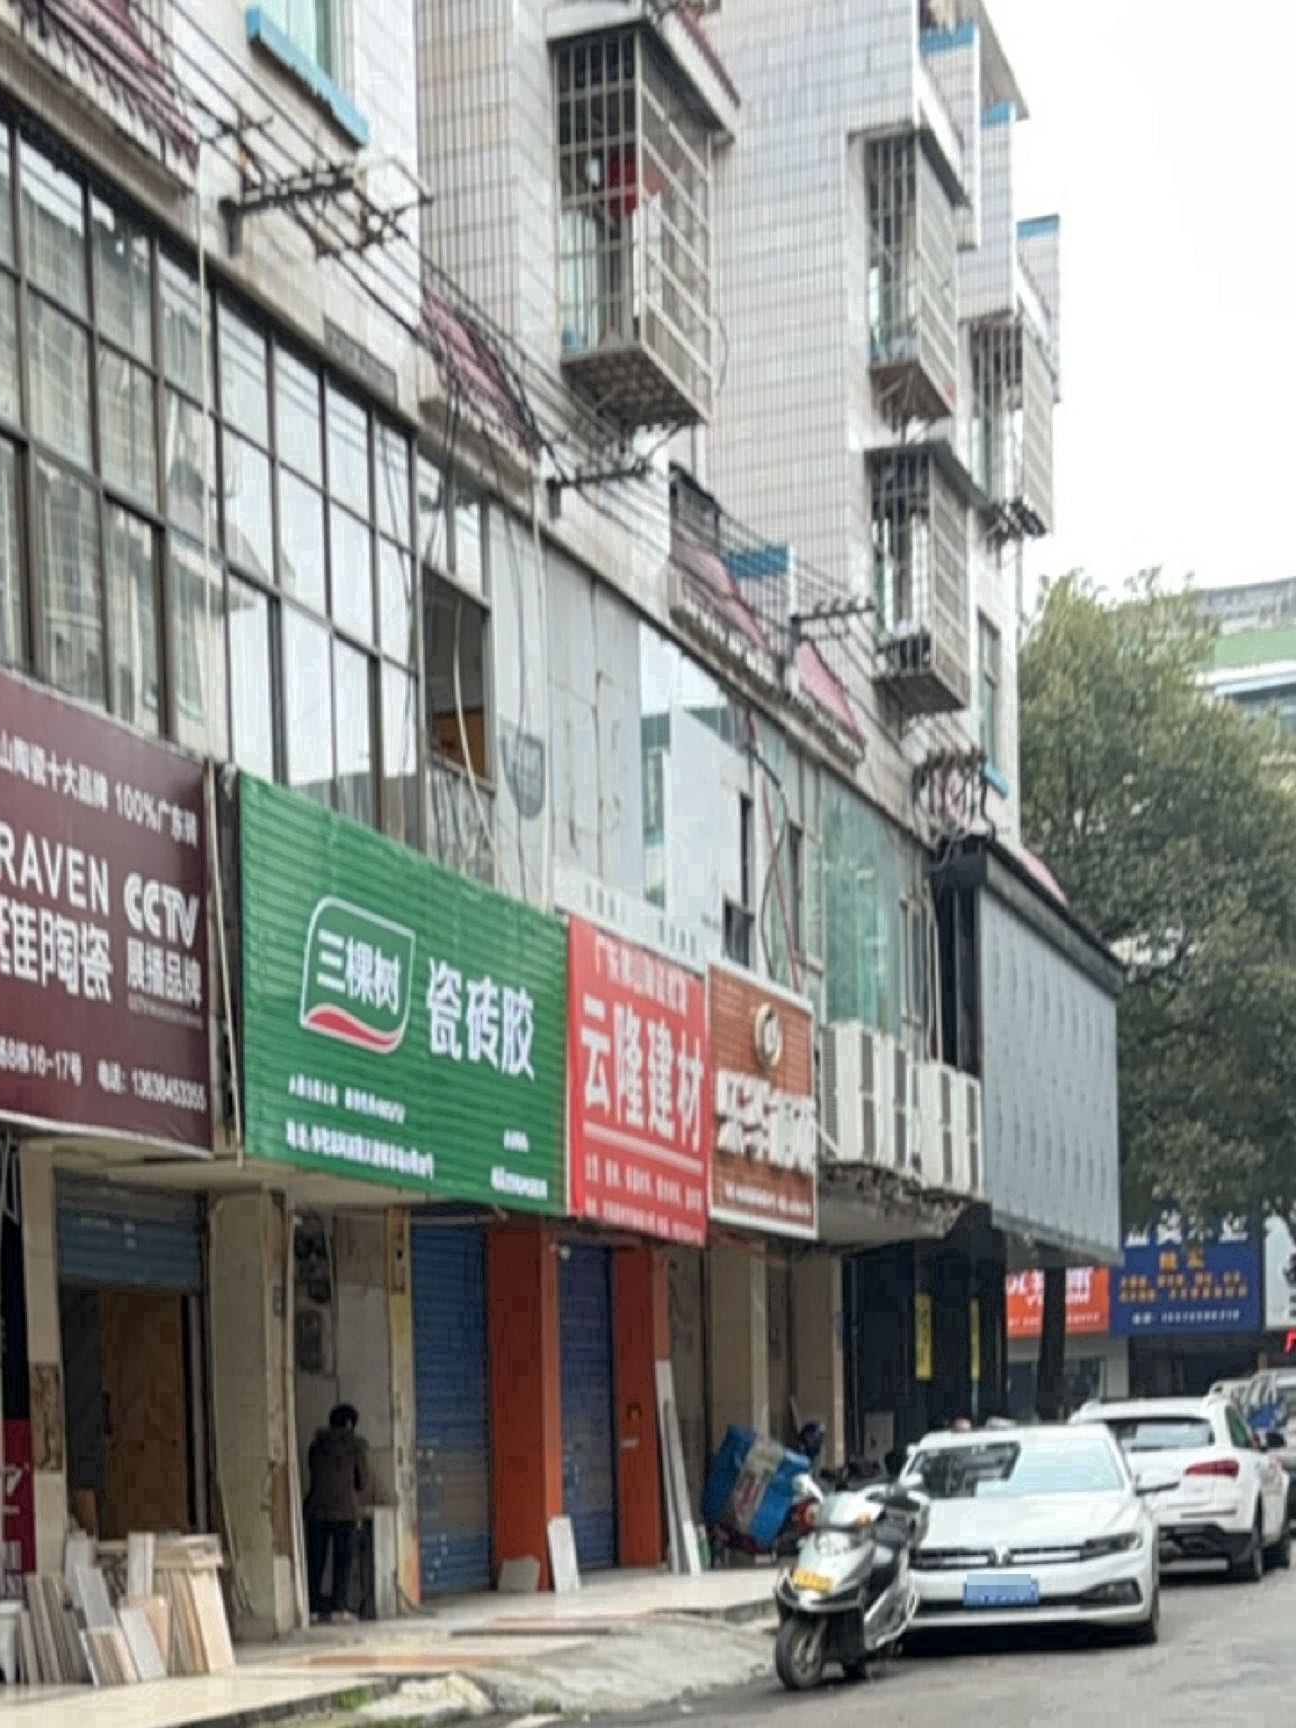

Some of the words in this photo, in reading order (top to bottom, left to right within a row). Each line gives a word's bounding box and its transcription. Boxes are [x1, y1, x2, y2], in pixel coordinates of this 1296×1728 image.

[123, 872, 202, 950] CCTV
[316, 928, 401, 1016] 三棵树
[425, 956, 536, 1081] 瓷砖胶
[580, 994, 704, 1152] 云隆建材
